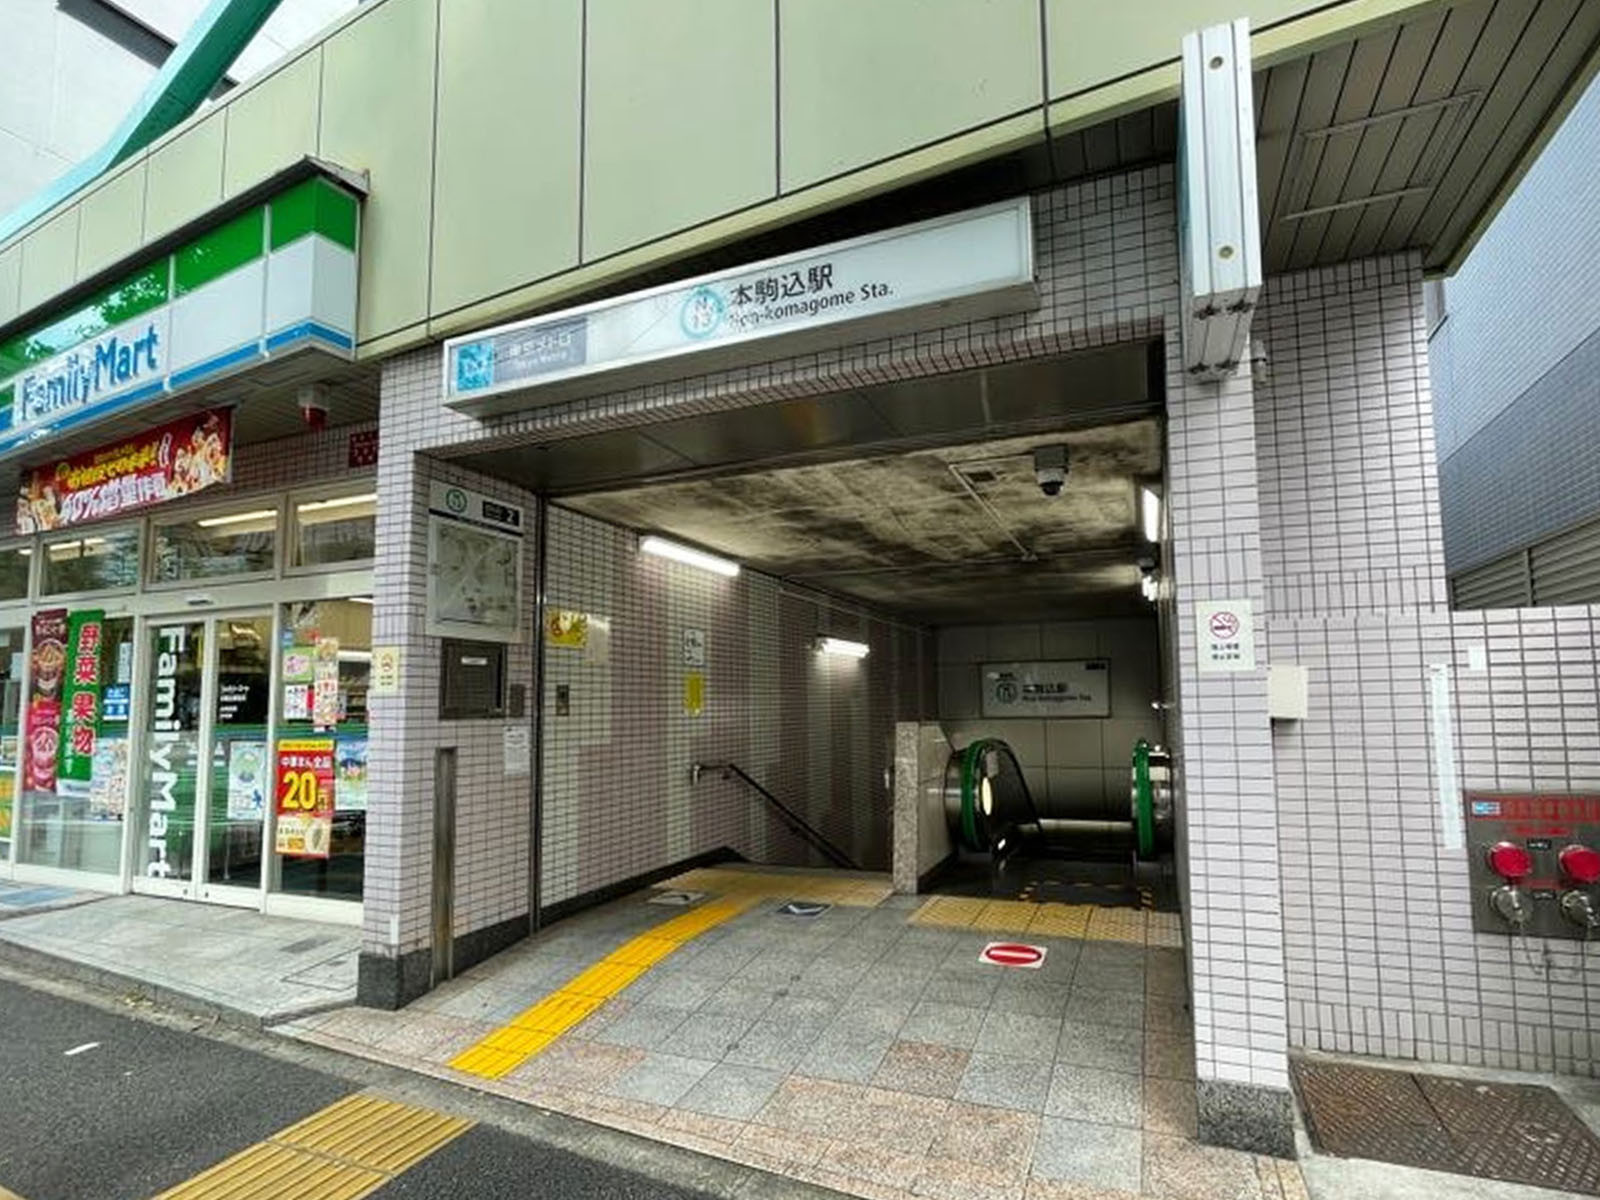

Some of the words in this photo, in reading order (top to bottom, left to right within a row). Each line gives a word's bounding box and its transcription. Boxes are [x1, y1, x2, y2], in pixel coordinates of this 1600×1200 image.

[730, 263, 833, 307] 本駒込駅
[860, 282, 894, 302] Sta.
[21, 323, 159, 421] FamilyMart
[148, 626, 186, 878] FamilyMart
